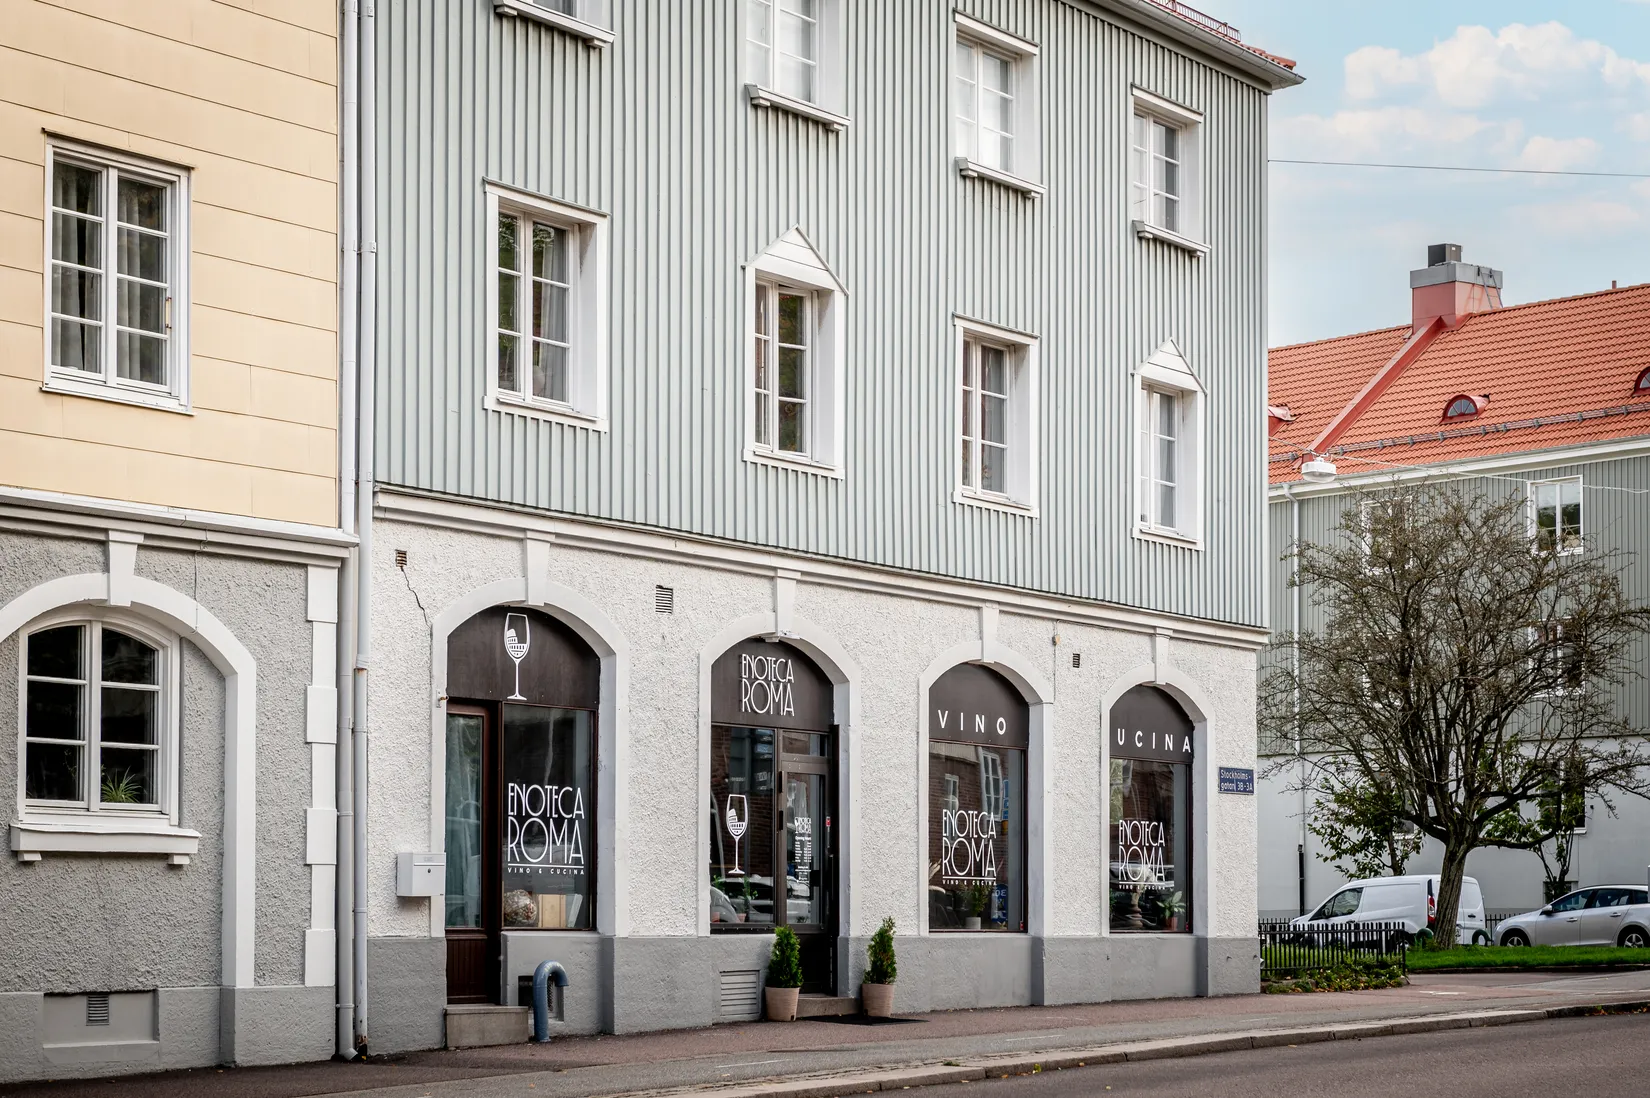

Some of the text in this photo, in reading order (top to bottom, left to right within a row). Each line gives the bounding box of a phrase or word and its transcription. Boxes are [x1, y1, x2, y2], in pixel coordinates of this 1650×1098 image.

[742, 653, 795, 683] ENOTECA
[742, 678, 795, 717] ROMA
[938, 709, 1007, 736] VINO
[1117, 728, 1192, 753] UCINA
[508, 782, 585, 819] ENOTECA
[1220, 782, 1235, 791] gatan
[942, 809, 997, 839] ENOTECA
[1118, 819, 1166, 847] ENOTECA
[507, 816, 585, 865] ROMA
[942, 837, 997, 877] ROMA
[1118, 845, 1166, 882] ROMA
